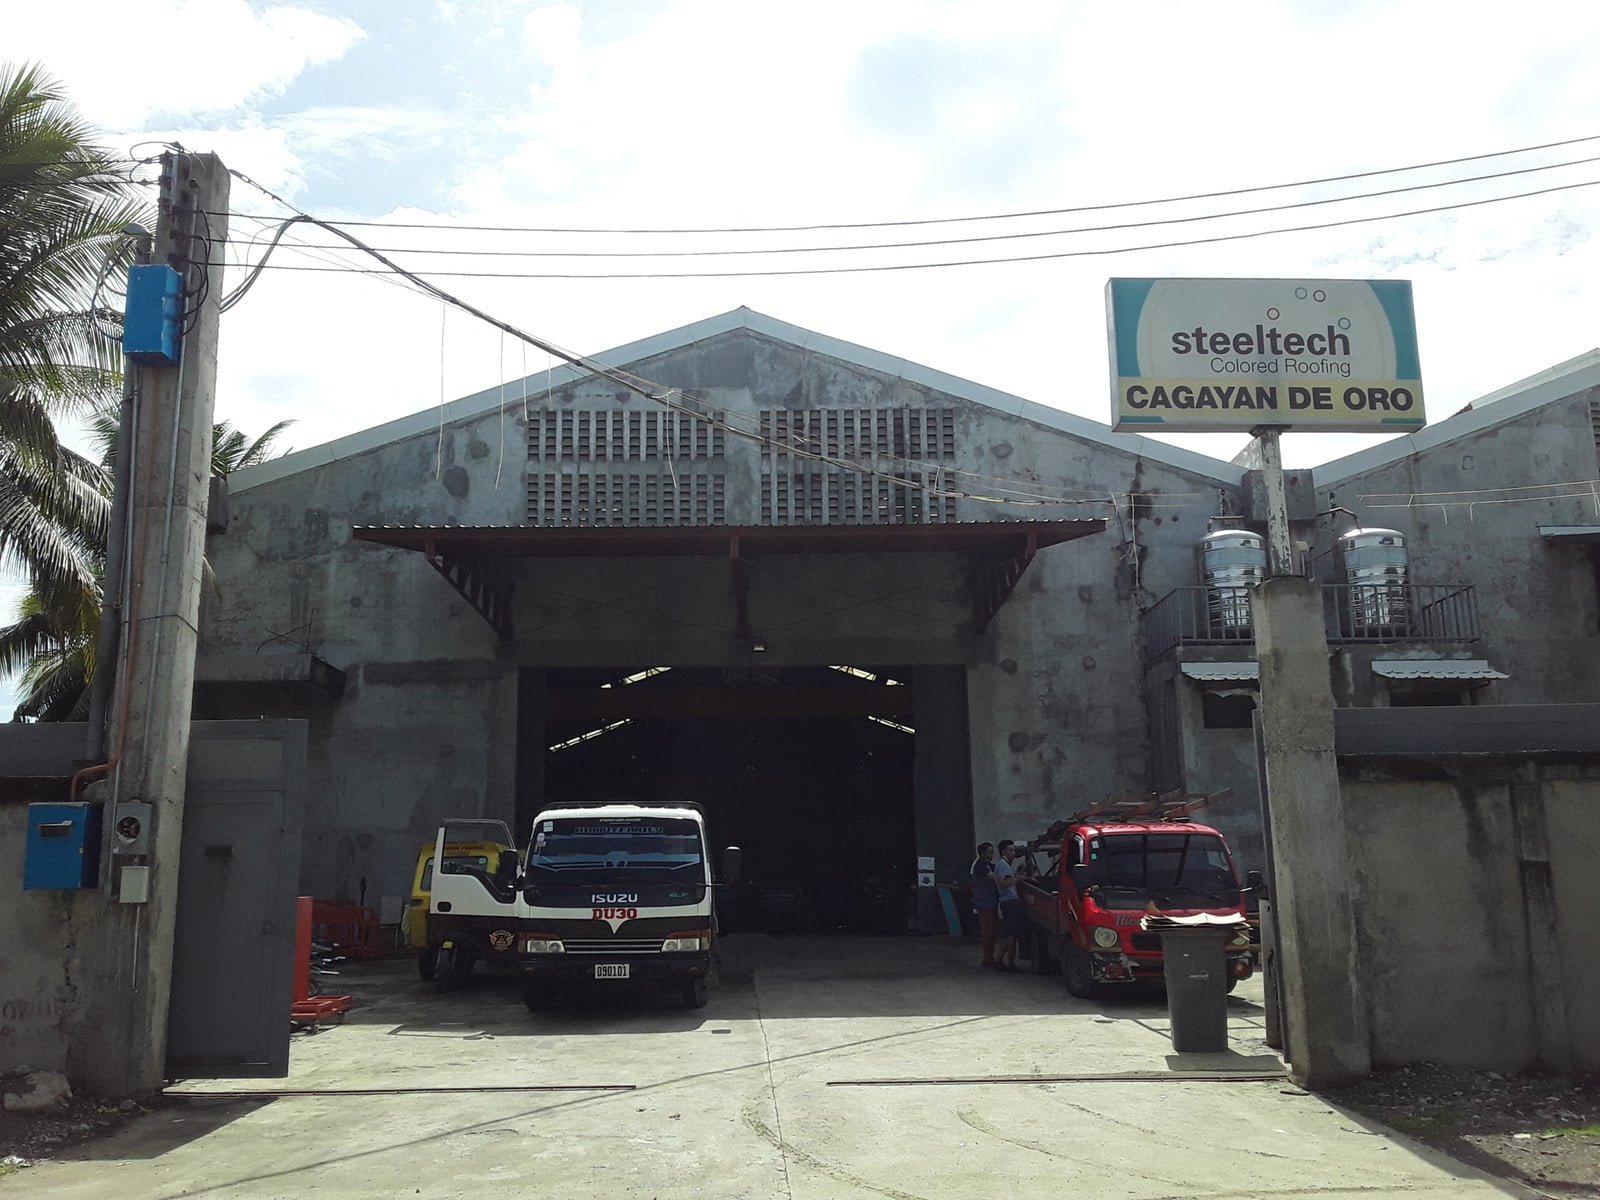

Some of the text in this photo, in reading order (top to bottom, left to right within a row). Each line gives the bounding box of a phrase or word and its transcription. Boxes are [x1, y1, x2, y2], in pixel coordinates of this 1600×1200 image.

[1171, 324, 1350, 356] steeltech
[1210, 357, 1352, 378] Colored Roofing
[1126, 385, 1414, 412] CAGAYAN DE ORO
[591, 893, 638, 904] ISUZU
[592, 908, 638, 920] DU30
